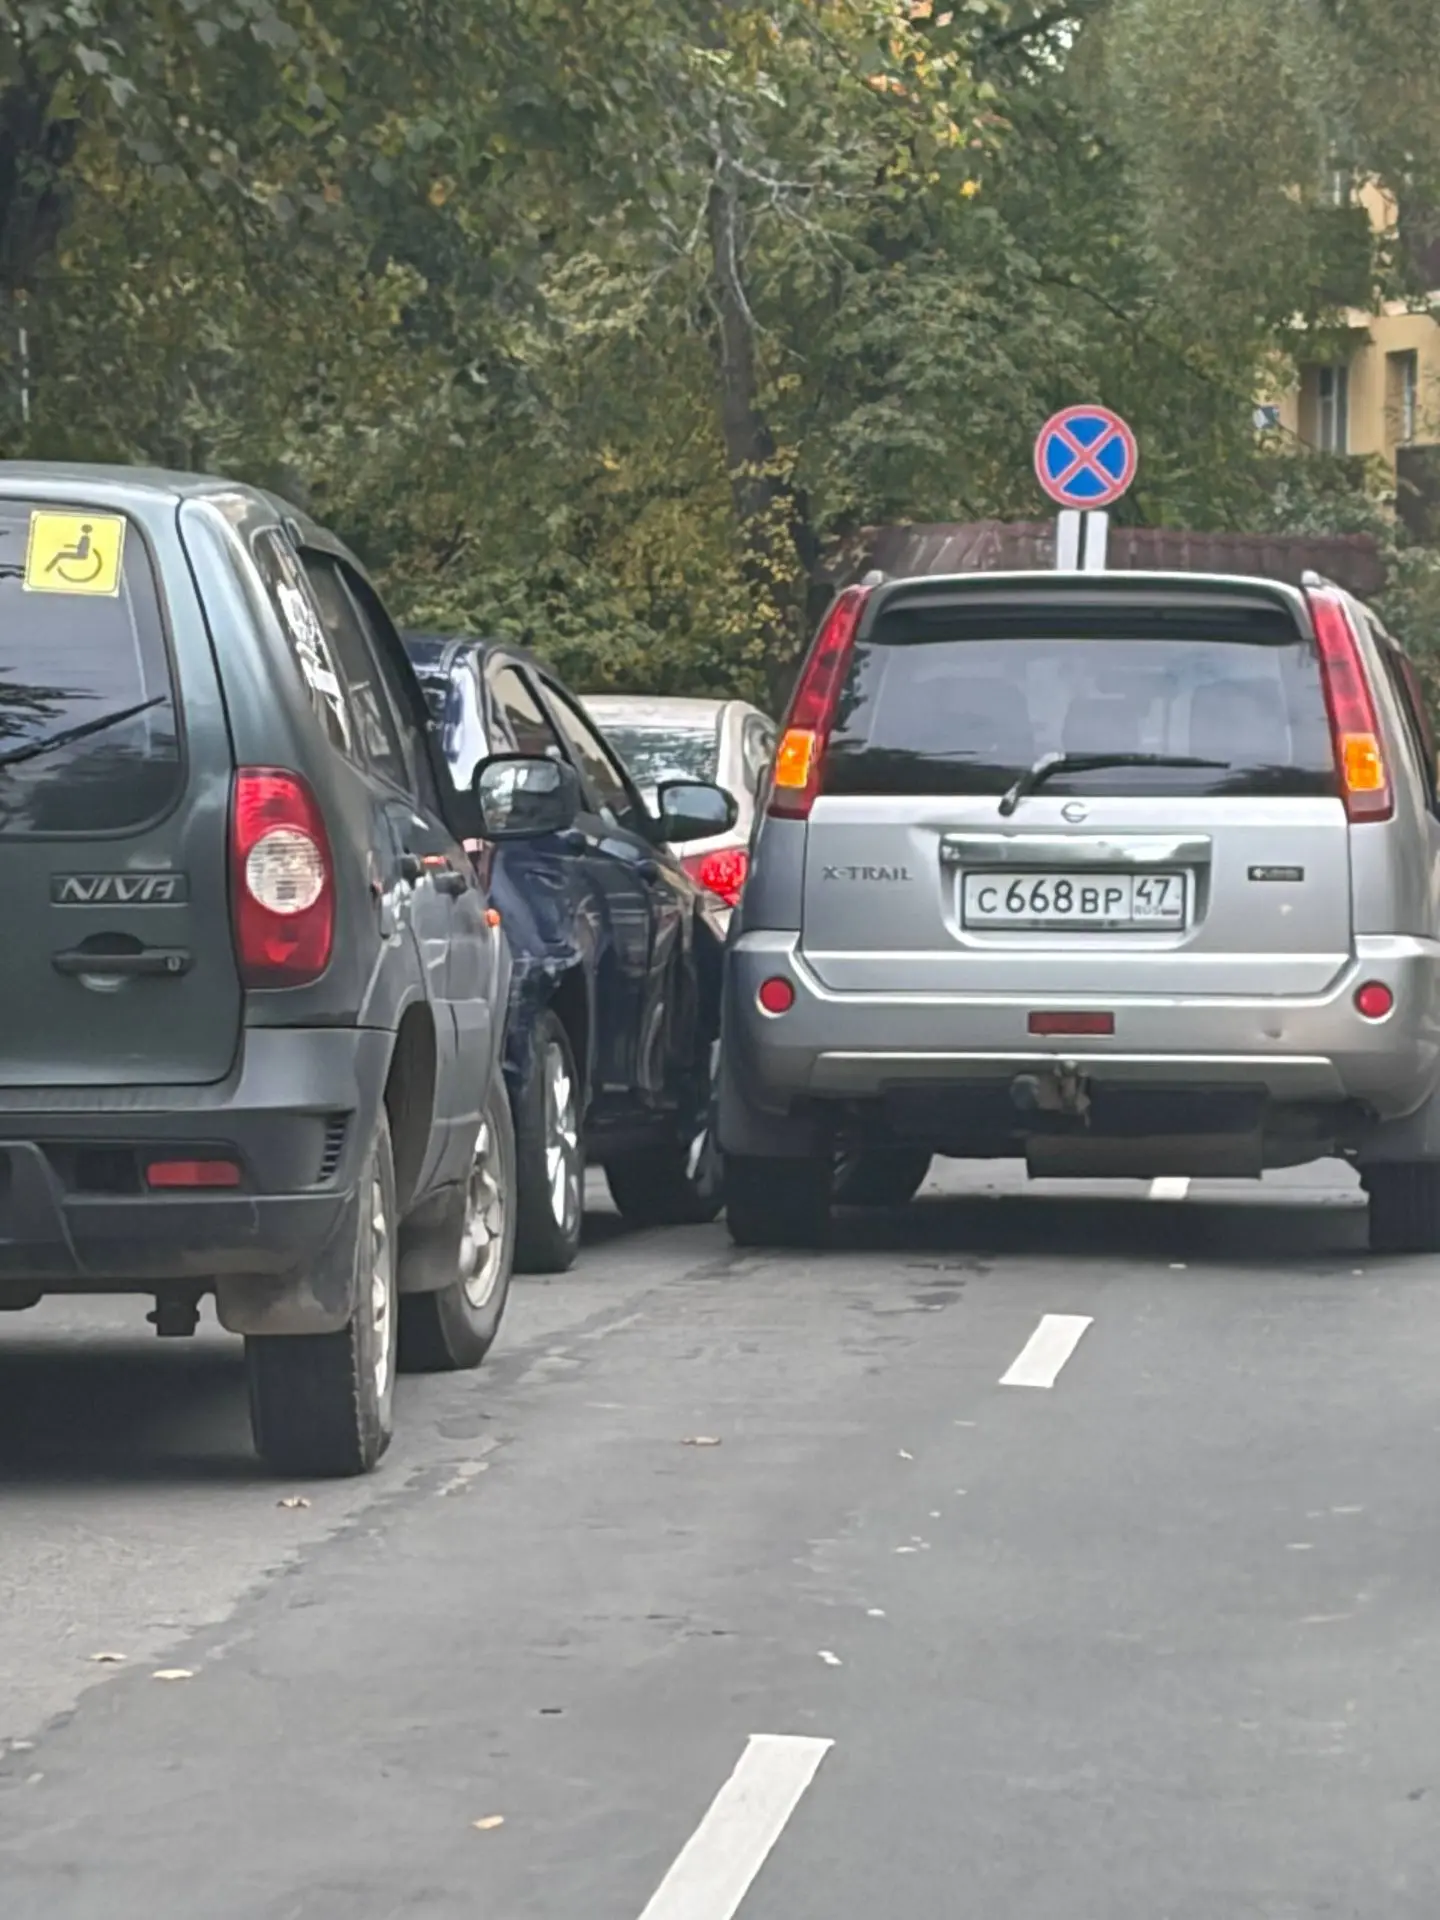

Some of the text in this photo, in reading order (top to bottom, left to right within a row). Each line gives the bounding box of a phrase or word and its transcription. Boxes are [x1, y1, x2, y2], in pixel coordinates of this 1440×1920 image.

[822, 865, 913, 881] X-TRAIL
[60, 876, 176, 901] NIVA
[1135, 878, 1171, 906] 47
